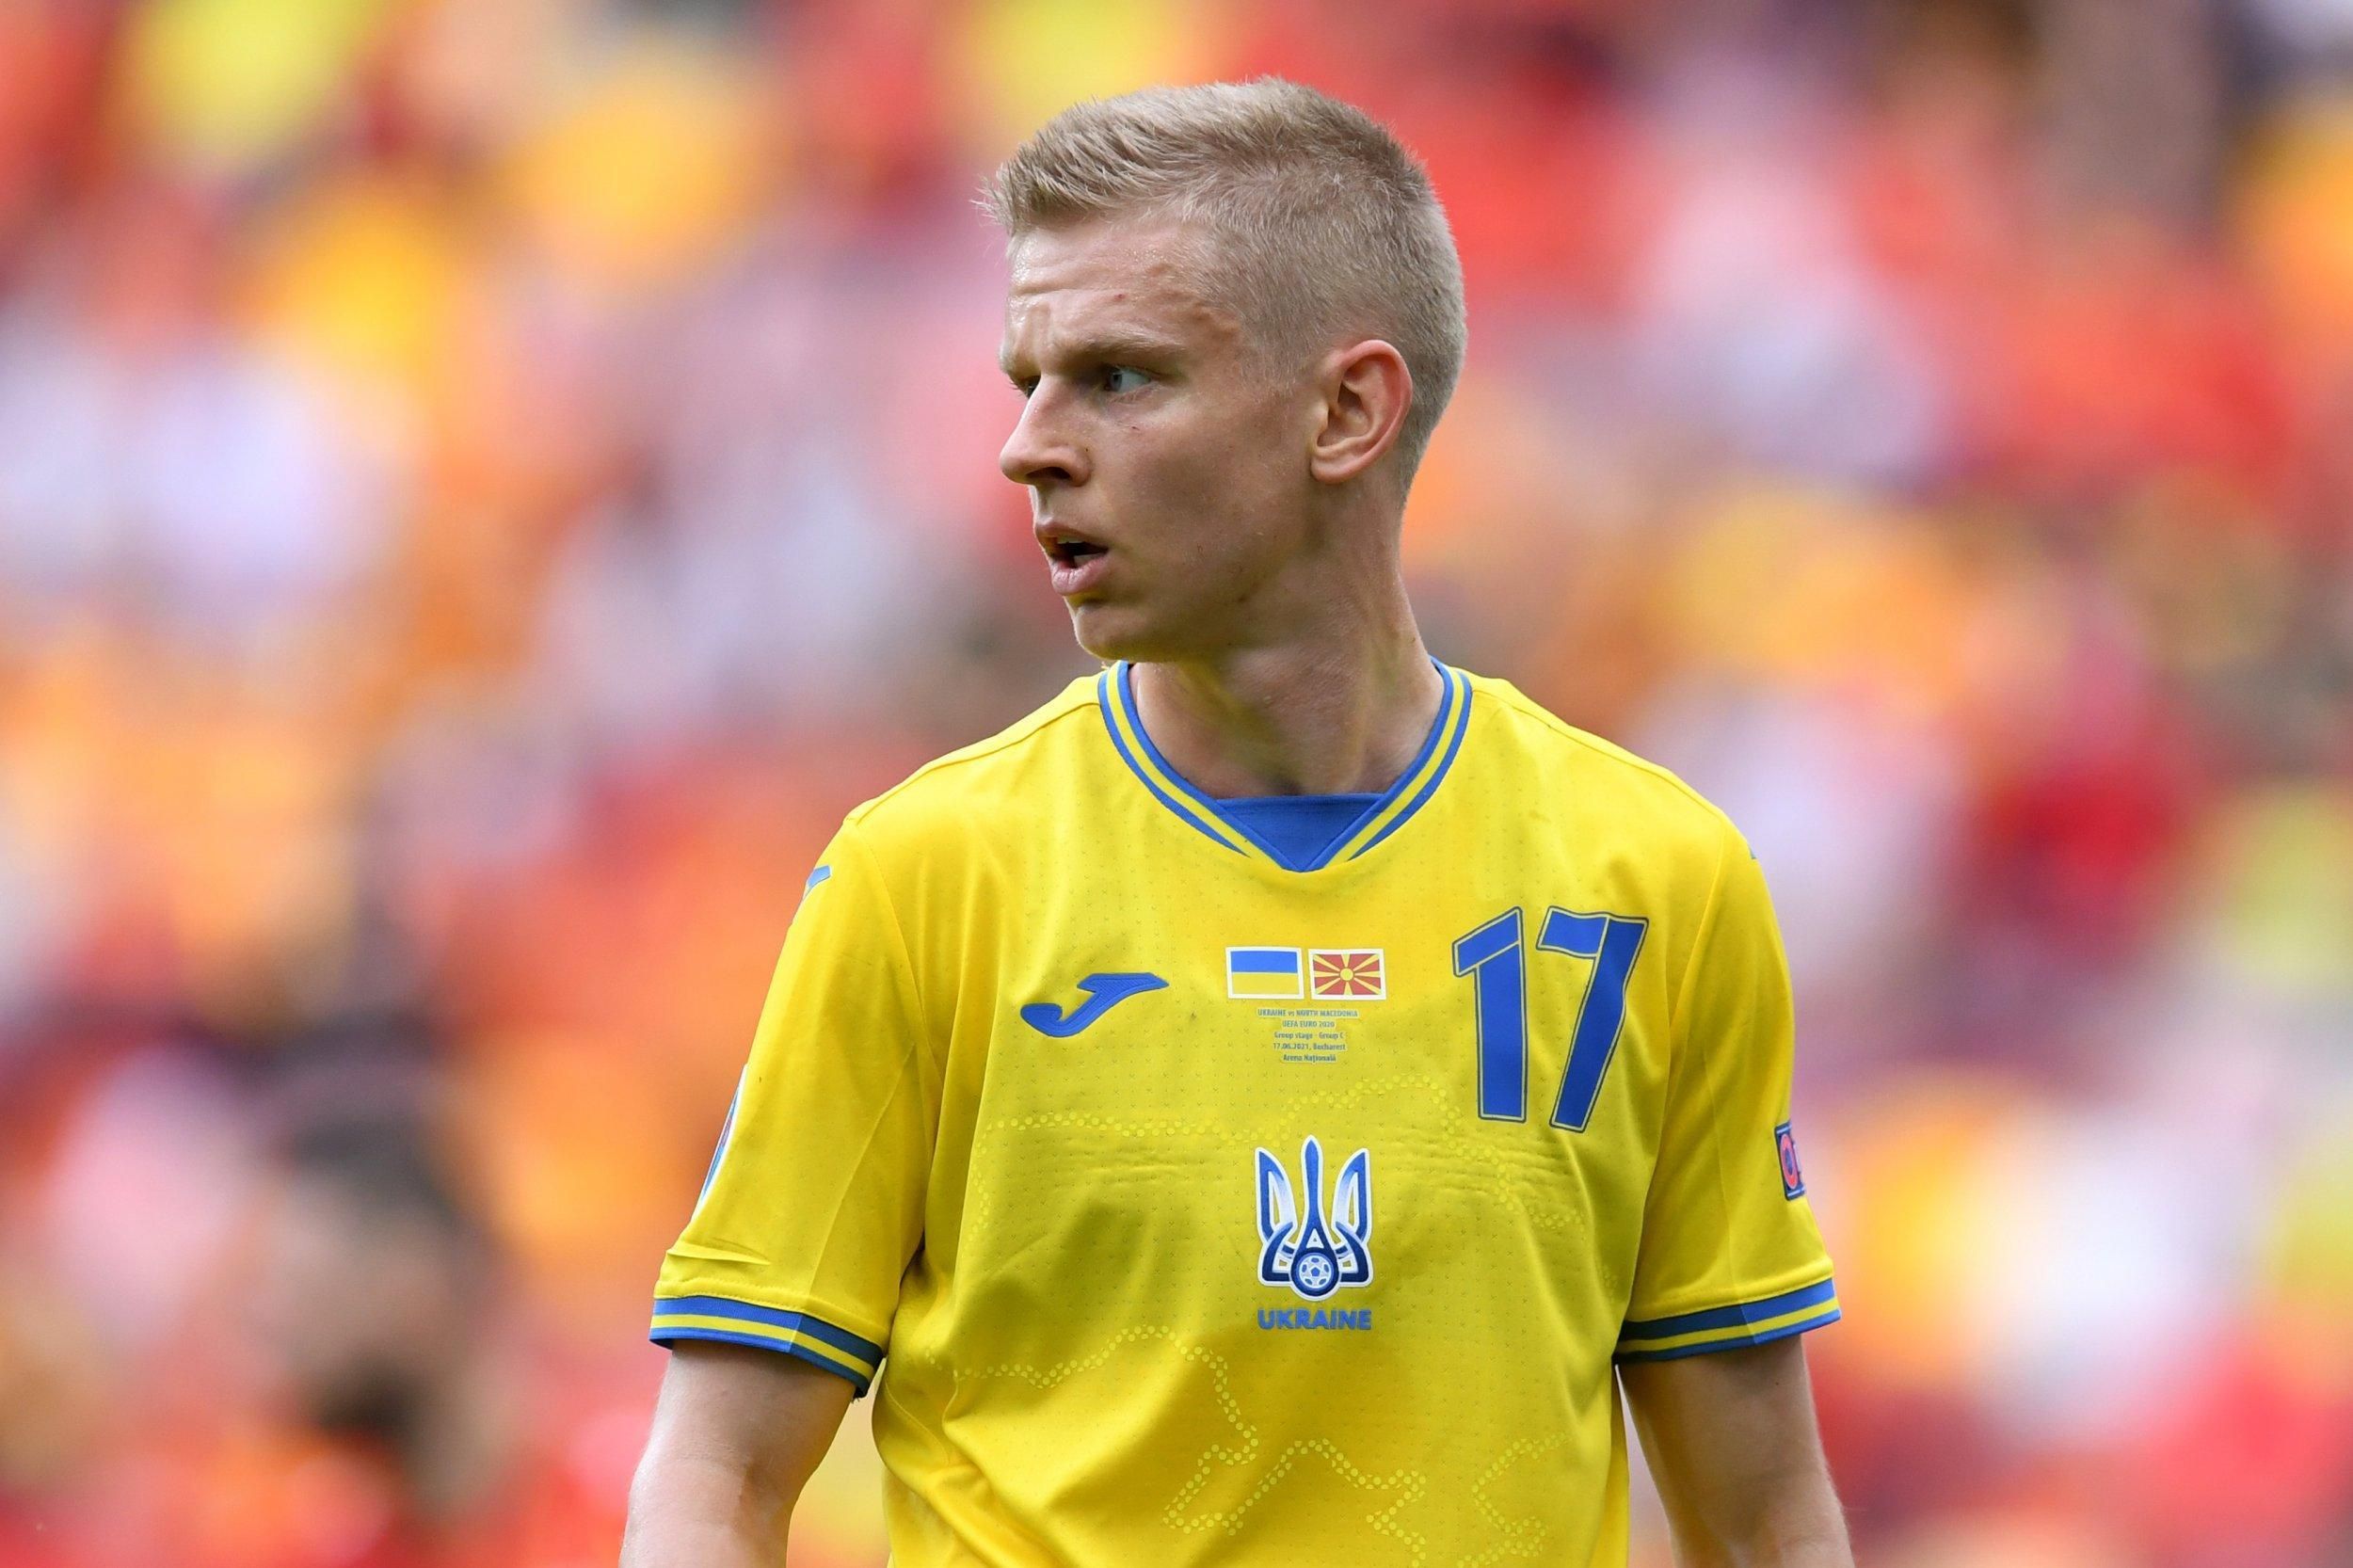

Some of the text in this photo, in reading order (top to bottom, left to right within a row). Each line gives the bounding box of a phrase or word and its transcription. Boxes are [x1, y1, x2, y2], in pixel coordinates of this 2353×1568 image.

[1452, 905, 1649, 1133] 17
[1273, 1032, 1294, 1040] Group
[1319, 1032, 1338, 1040] Group
[1257, 1309, 1371, 1331] UKRAINE
